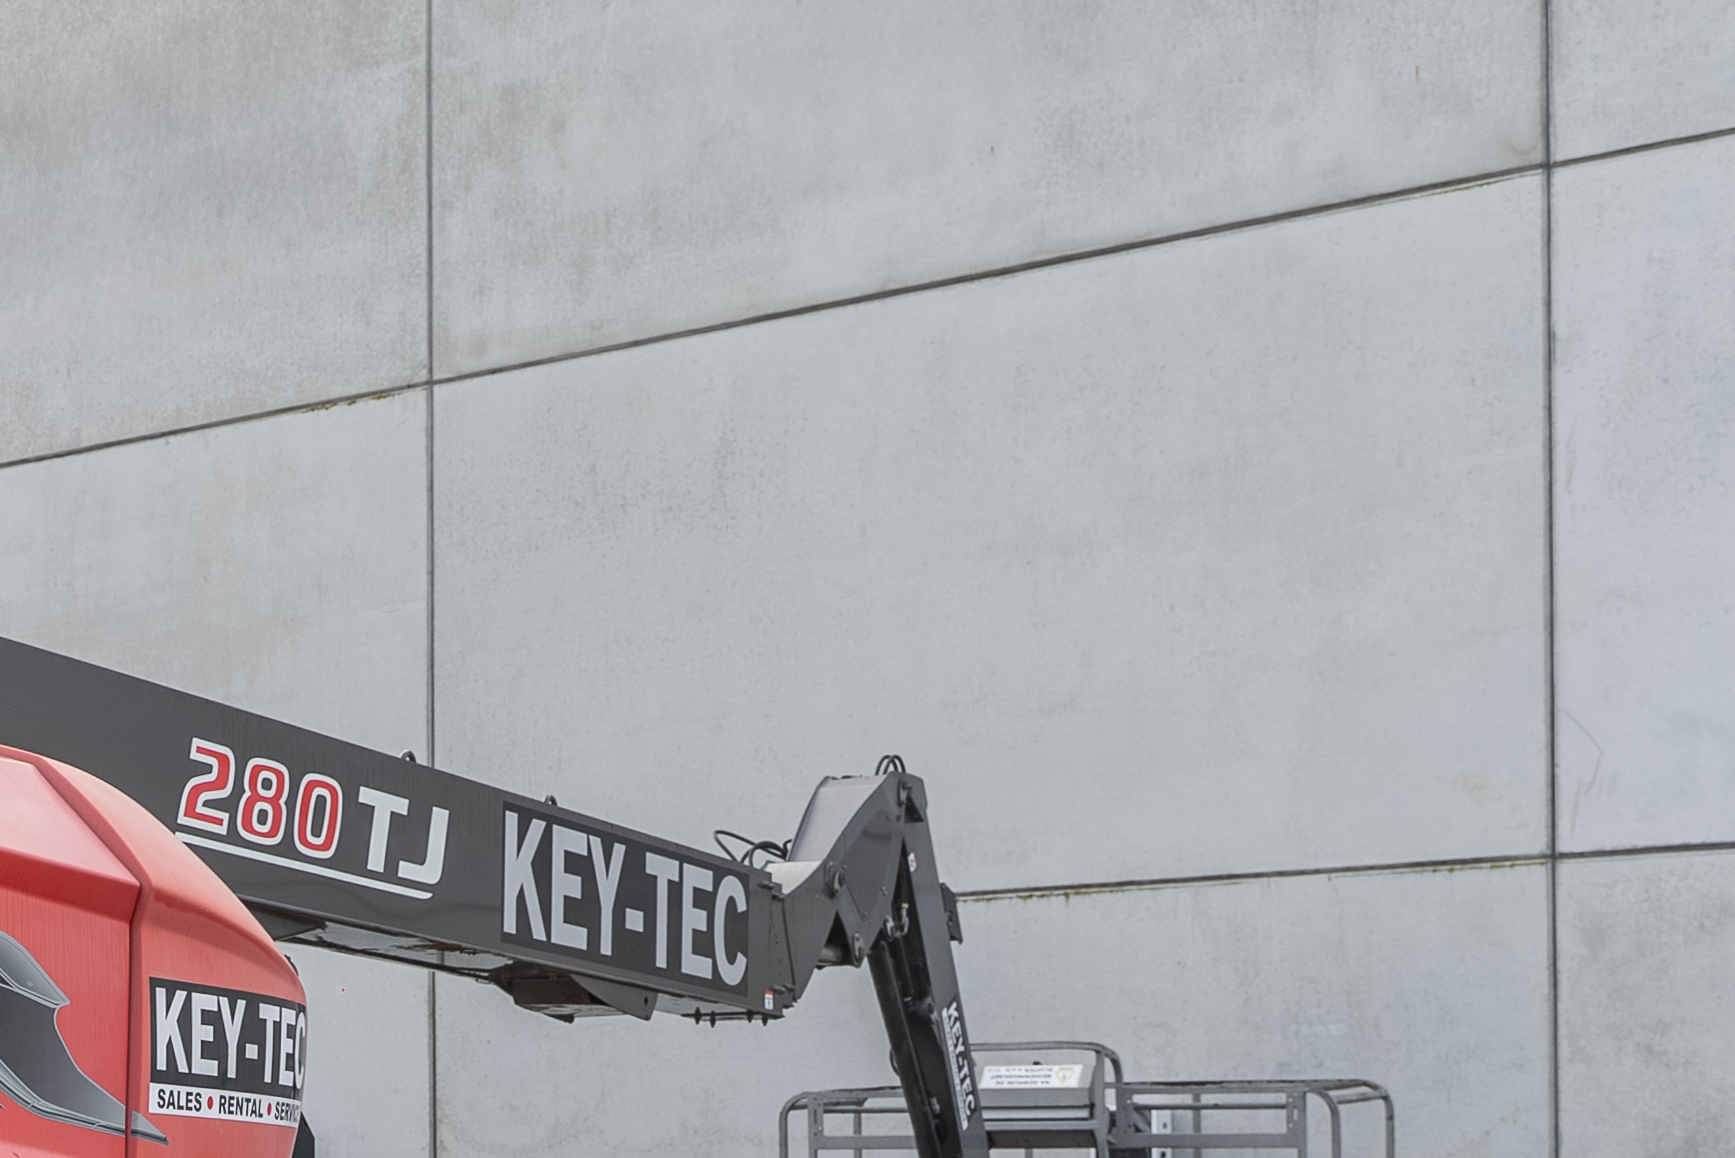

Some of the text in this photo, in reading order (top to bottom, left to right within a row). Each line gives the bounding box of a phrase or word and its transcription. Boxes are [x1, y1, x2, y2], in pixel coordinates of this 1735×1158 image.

[177, 737, 450, 885] 280 TJ
[503, 809, 748, 987] KEY-TEC
[155, 986, 306, 1090] KEY-TEC
[948, 1001, 975, 1116] KEY-TEC
[157, 1088, 202, 1112] SALES
[218, 1094, 264, 1119] RENTAL
